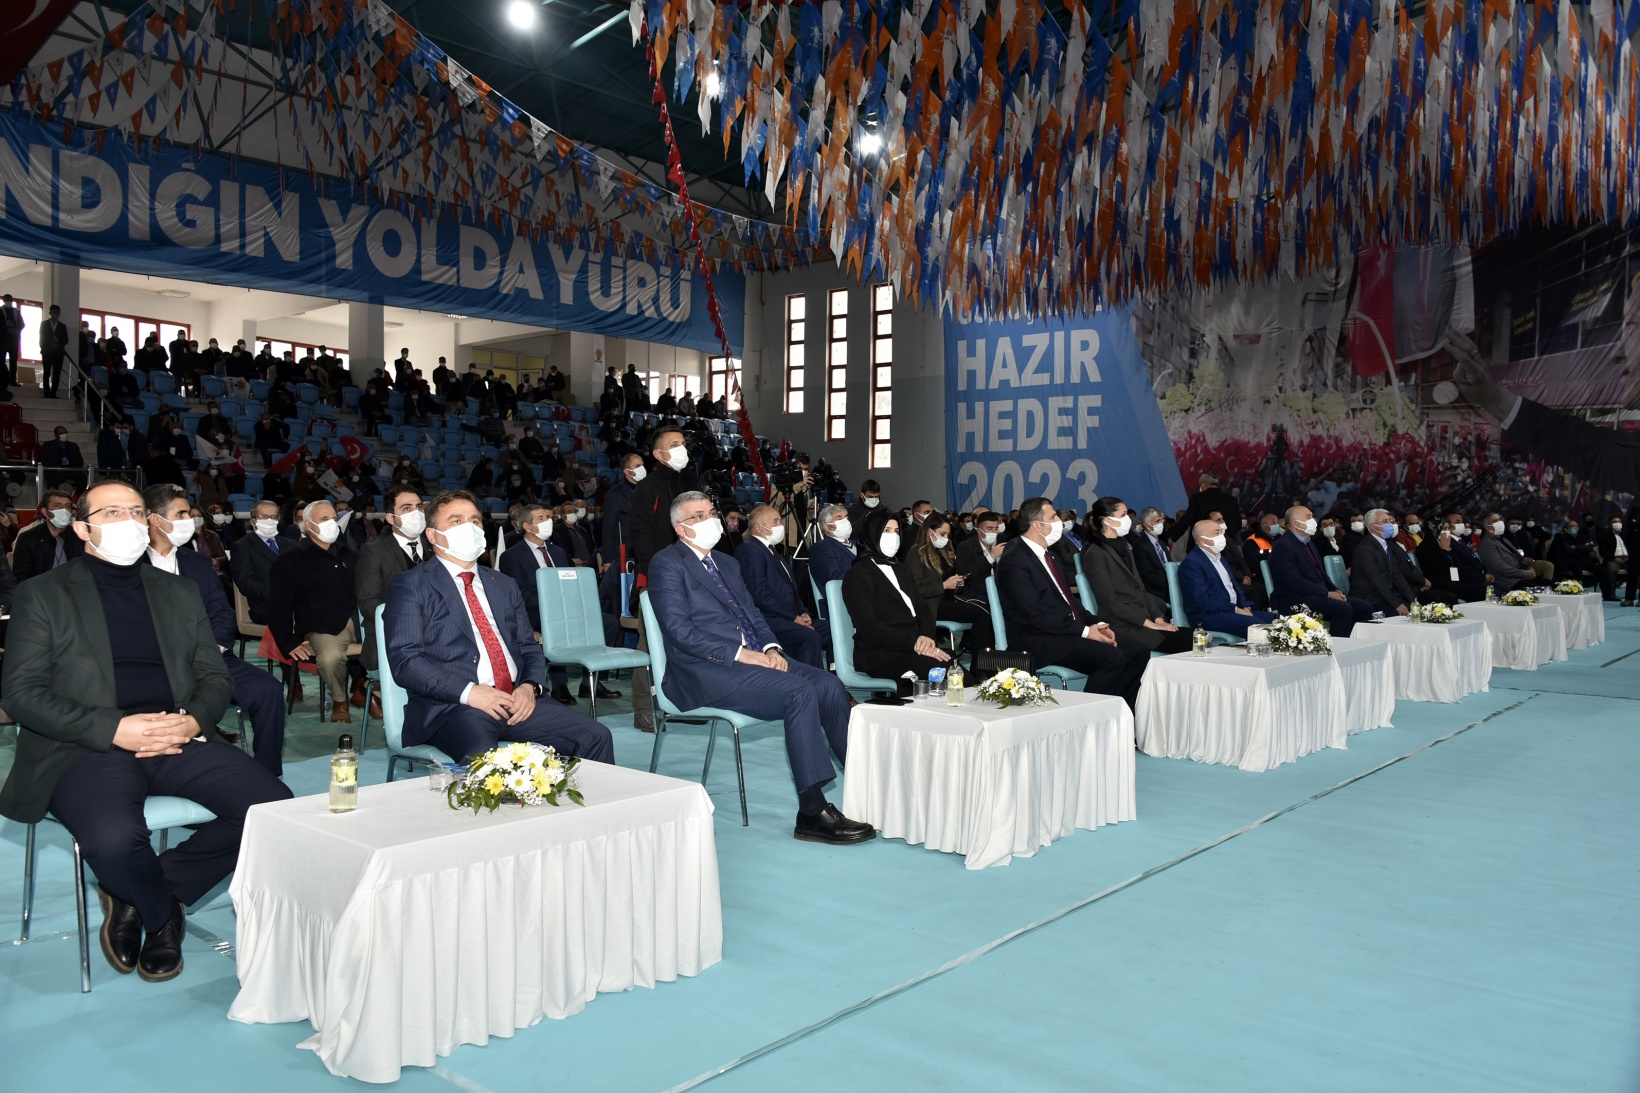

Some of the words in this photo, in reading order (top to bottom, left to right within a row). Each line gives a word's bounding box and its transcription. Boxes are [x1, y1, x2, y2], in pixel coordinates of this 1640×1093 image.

[318, 198, 544, 300] YOLDA
[548, 242, 692, 323] YÜRÜ
[957, 328, 1102, 391] HAZIR
[957, 394, 1102, 453] HEDEF
[957, 458, 1100, 517] 2023
